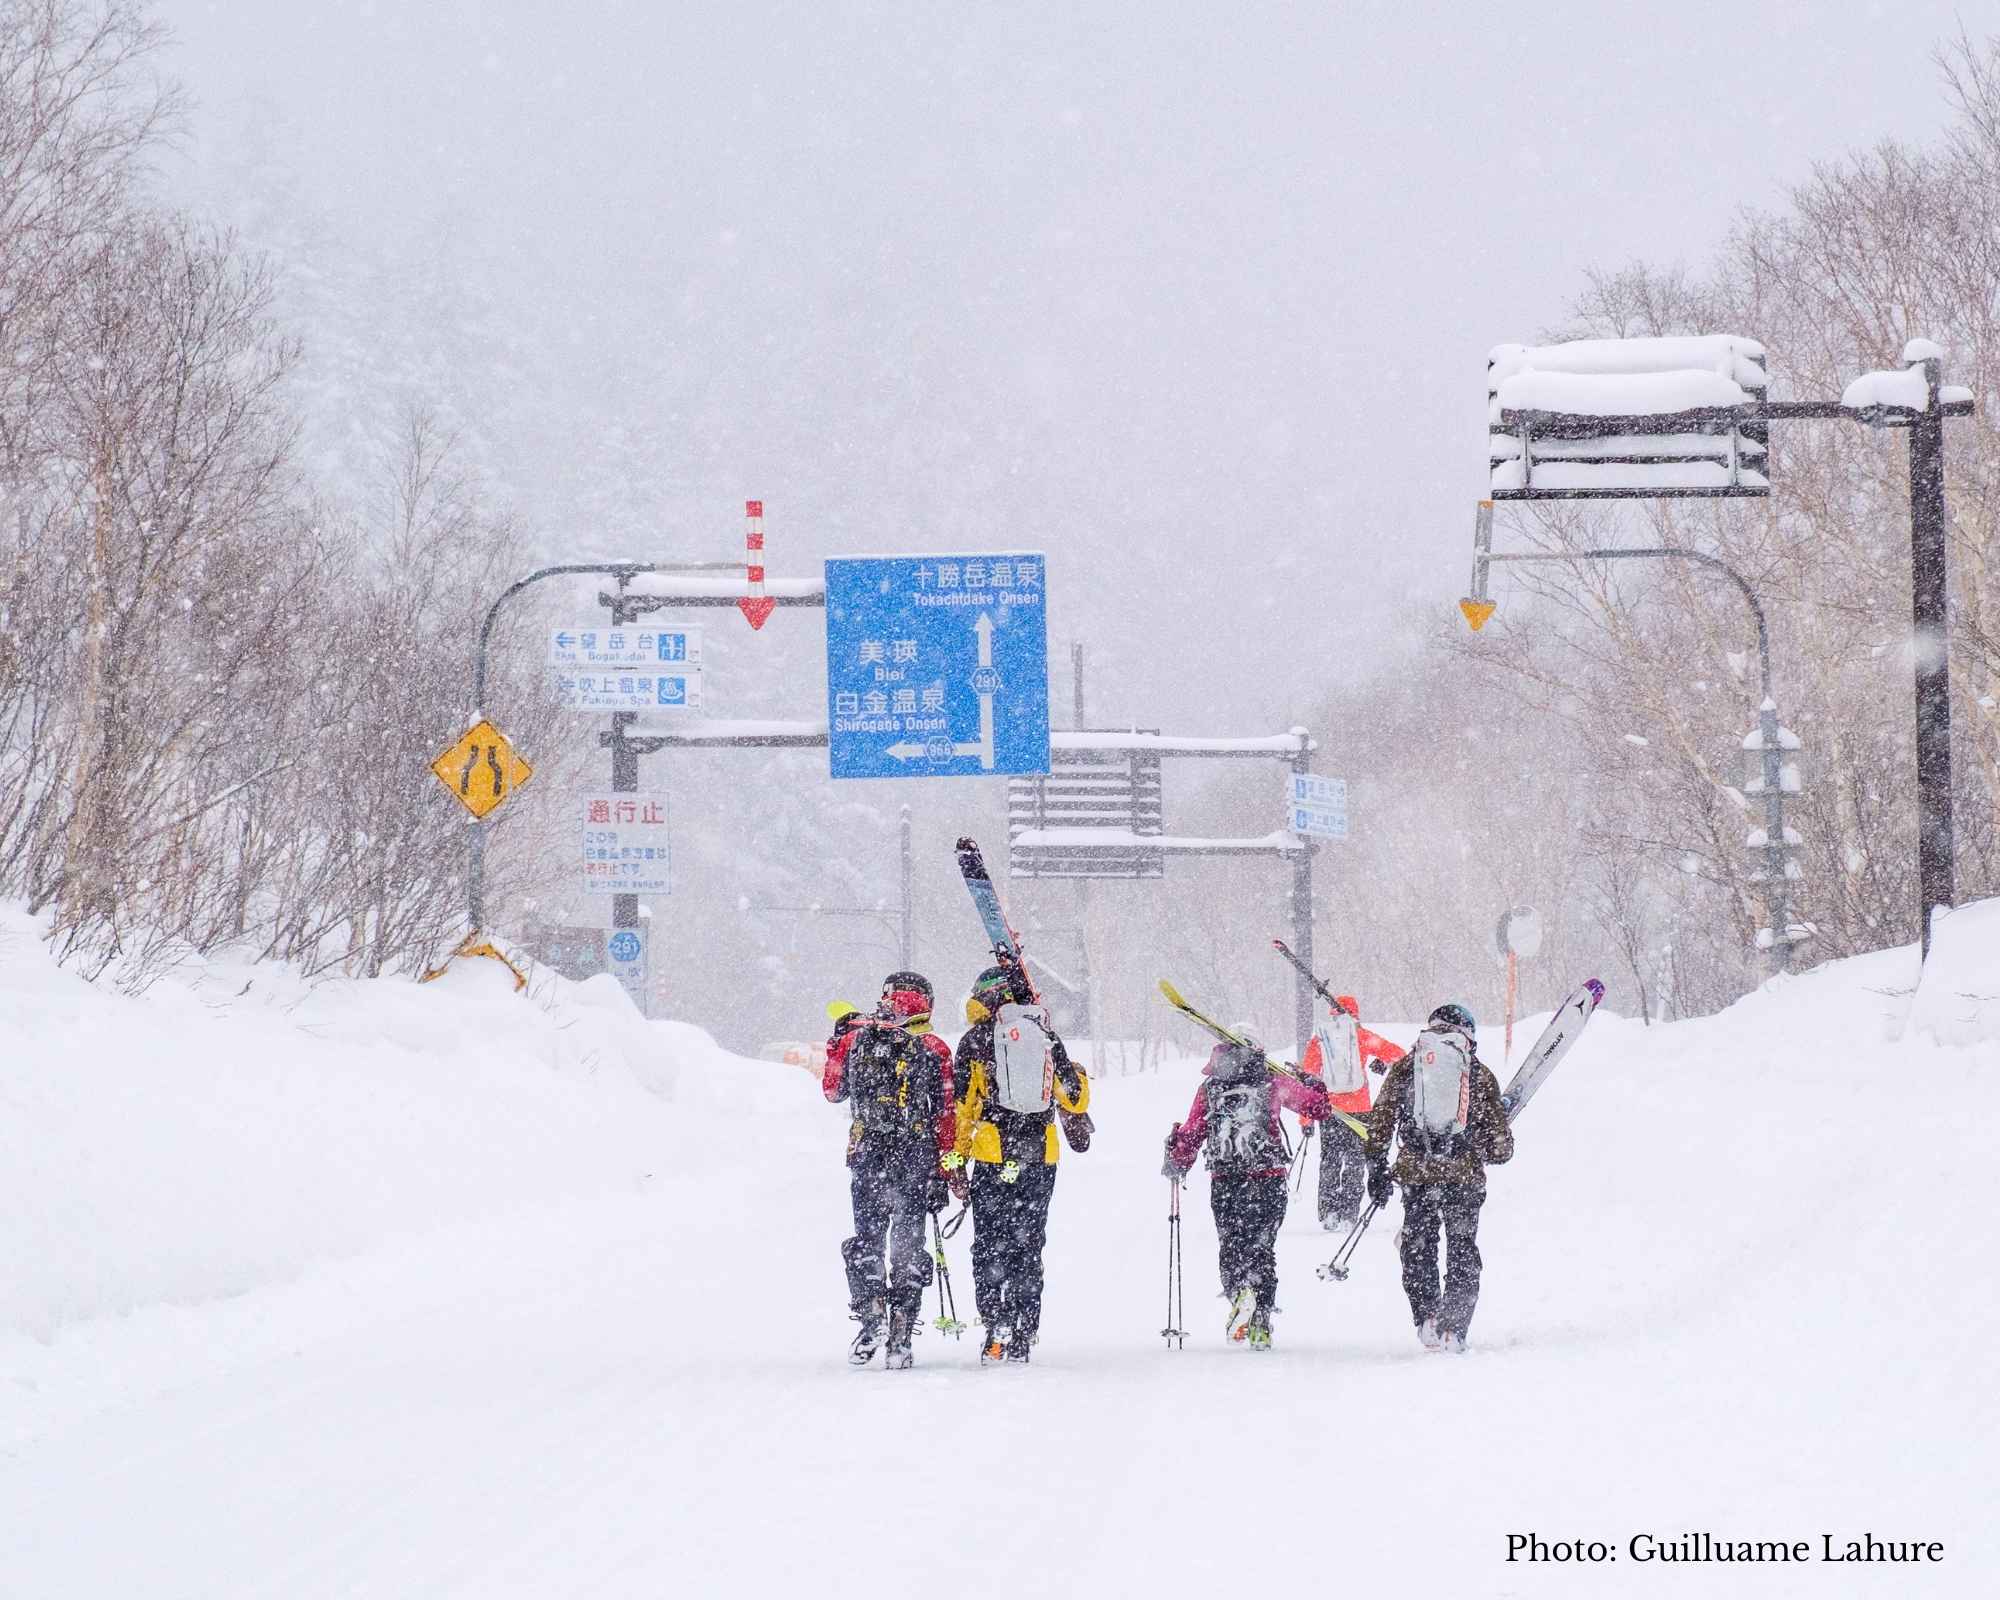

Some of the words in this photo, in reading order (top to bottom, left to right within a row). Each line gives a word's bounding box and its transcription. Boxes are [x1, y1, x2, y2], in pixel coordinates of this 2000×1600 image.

[912, 562, 1040, 589] 十勝岳温泉
[912, 592, 994, 606] Tokachidake
[999, 591, 1040, 605] Onsen
[580, 632, 654, 649] 望岳台
[858, 638, 918, 664] 美瑛
[874, 667, 905, 682] Biei
[974, 674, 997, 688] 291
[578, 677, 654, 694] 吹上温泉
[630, 695, 651, 707] Spa
[835, 688, 946, 715] 白金温泉
[835, 717, 900, 732] Shirogane
[906, 717, 947, 731] Onsen
[587, 799, 665, 824] 通行止
[614, 941, 638, 955] 291
